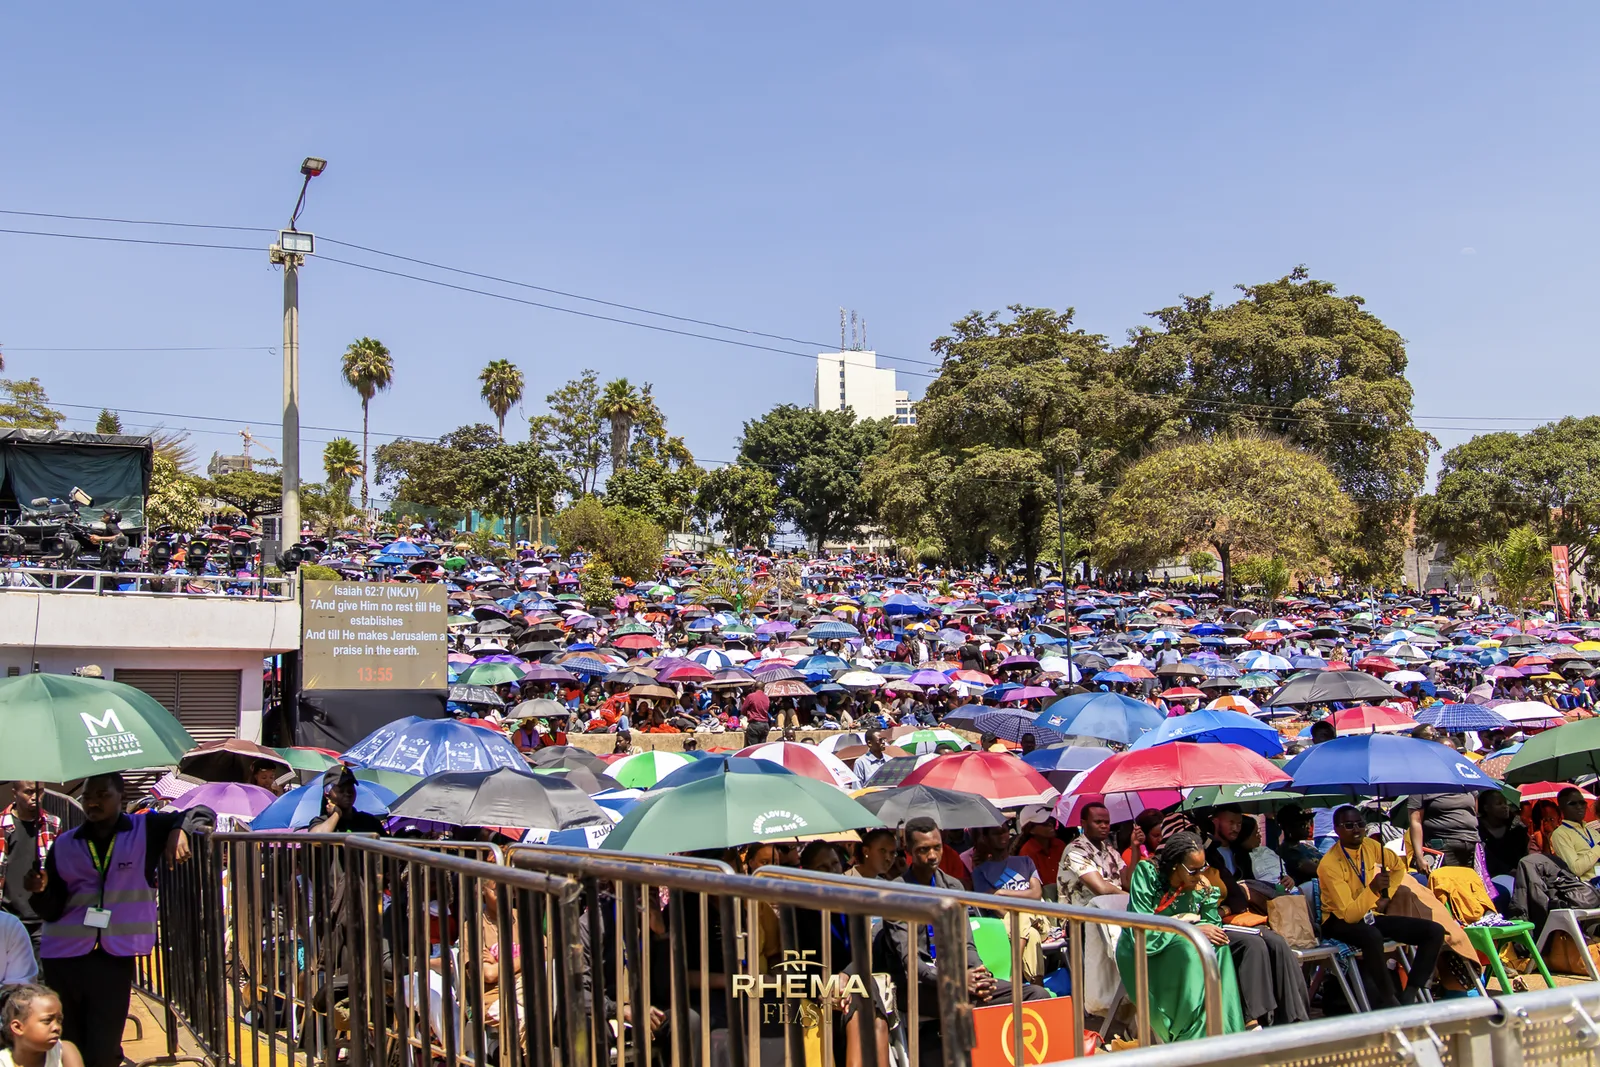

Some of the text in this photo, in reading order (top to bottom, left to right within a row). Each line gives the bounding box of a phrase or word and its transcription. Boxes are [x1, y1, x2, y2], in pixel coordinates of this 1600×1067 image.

[334, 585, 419, 600] Isaiah 62:7 (NKJV)
[310, 599, 442, 613] 7And give Him no rest till He
[350, 616, 403, 626] establishes
[305, 629, 446, 641] And till He makes Jerusalem a
[333, 645, 420, 658] praise in the earth.
[357, 667, 393, 681] 13:55
[80, 708, 125, 736] M
[85, 733, 138, 748] MAYFAIR
[88, 741, 141, 754] INSURANCE
[763, 810, 791, 819] LOVES
[792, 814, 808, 827] YOU
